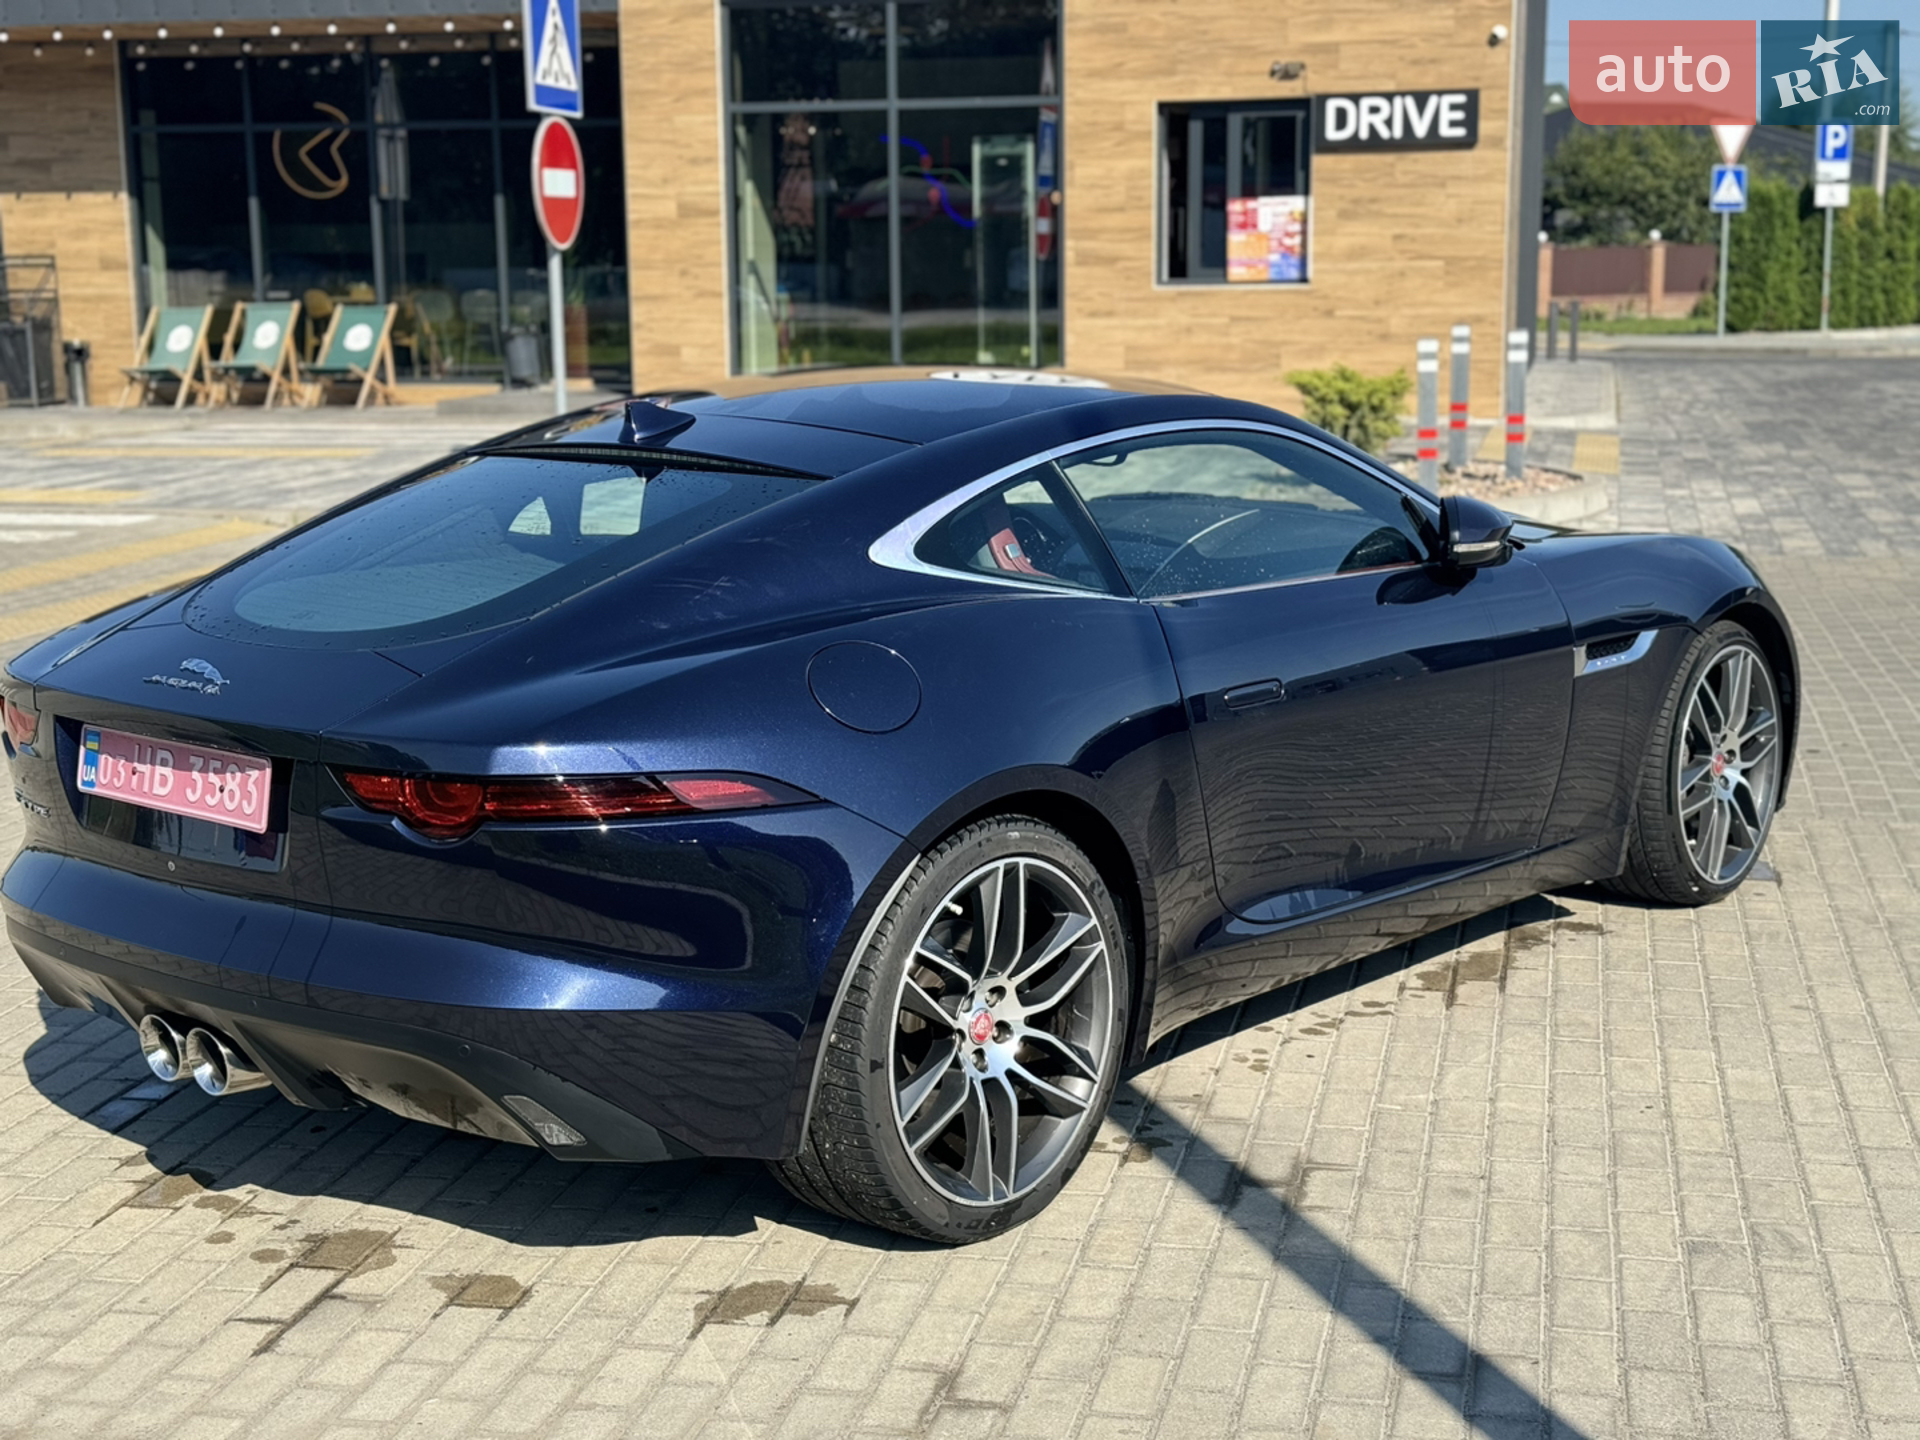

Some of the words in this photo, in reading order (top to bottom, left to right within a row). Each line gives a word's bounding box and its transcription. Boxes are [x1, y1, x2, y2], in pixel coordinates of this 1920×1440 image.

[1324, 93, 1468, 142] DRIVE
[1825, 123, 1848, 160] P
[82, 765, 97, 782] UA
[185, 755, 260, 815] 3583
